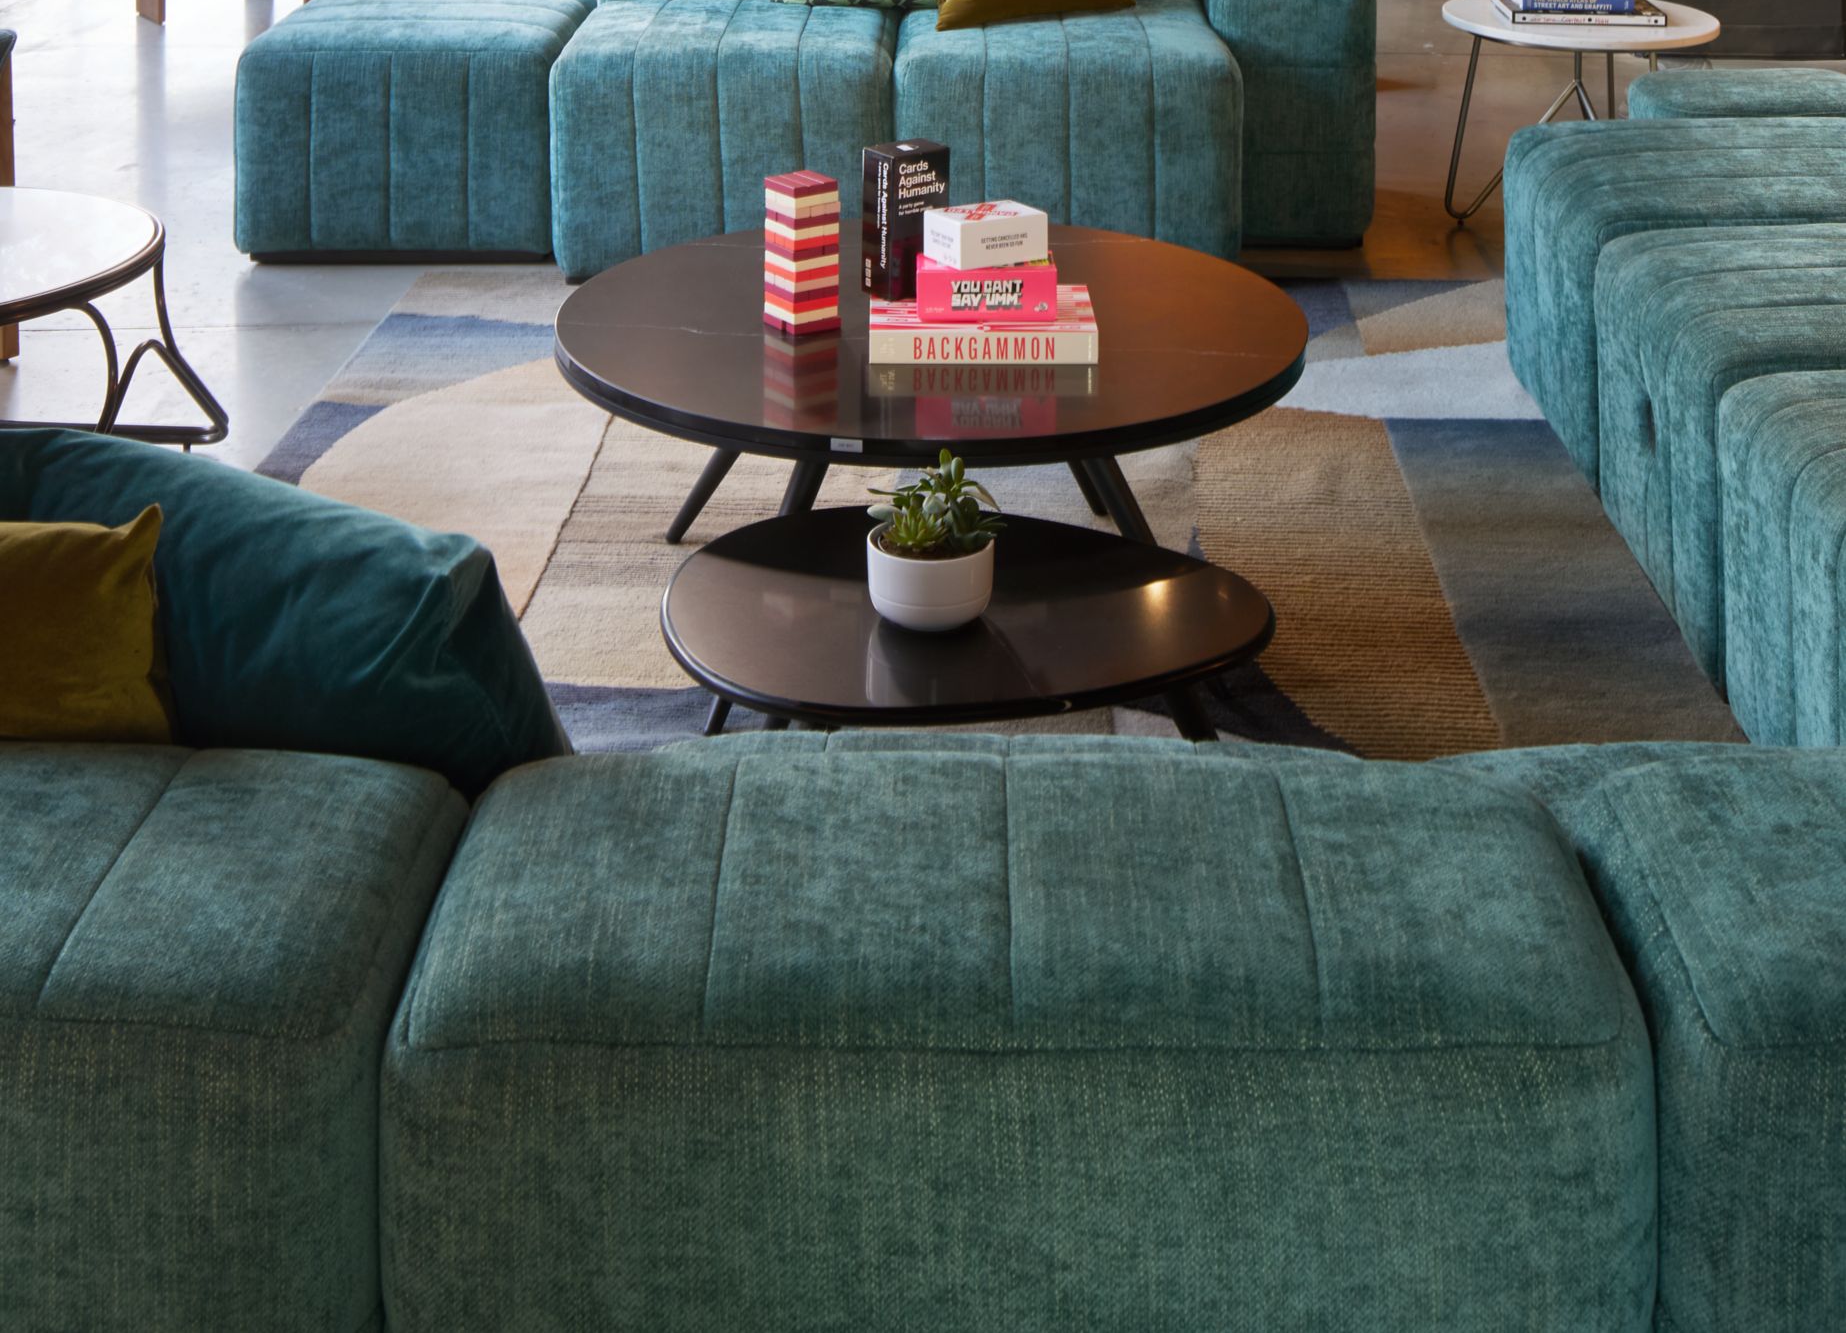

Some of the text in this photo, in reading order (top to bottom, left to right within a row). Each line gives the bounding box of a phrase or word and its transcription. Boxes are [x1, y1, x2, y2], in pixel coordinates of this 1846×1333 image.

[899, 160, 929, 175] Cards
[898, 170, 936, 188] Against
[898, 181, 945, 199] Humanity
[880, 226, 888, 269] Humanity
[981, 236, 998, 244] GETTING
[951, 280, 981, 294] YOU
[951, 293, 982, 308] SAY
[913, 337, 1055, 360] BACKGAMMON
